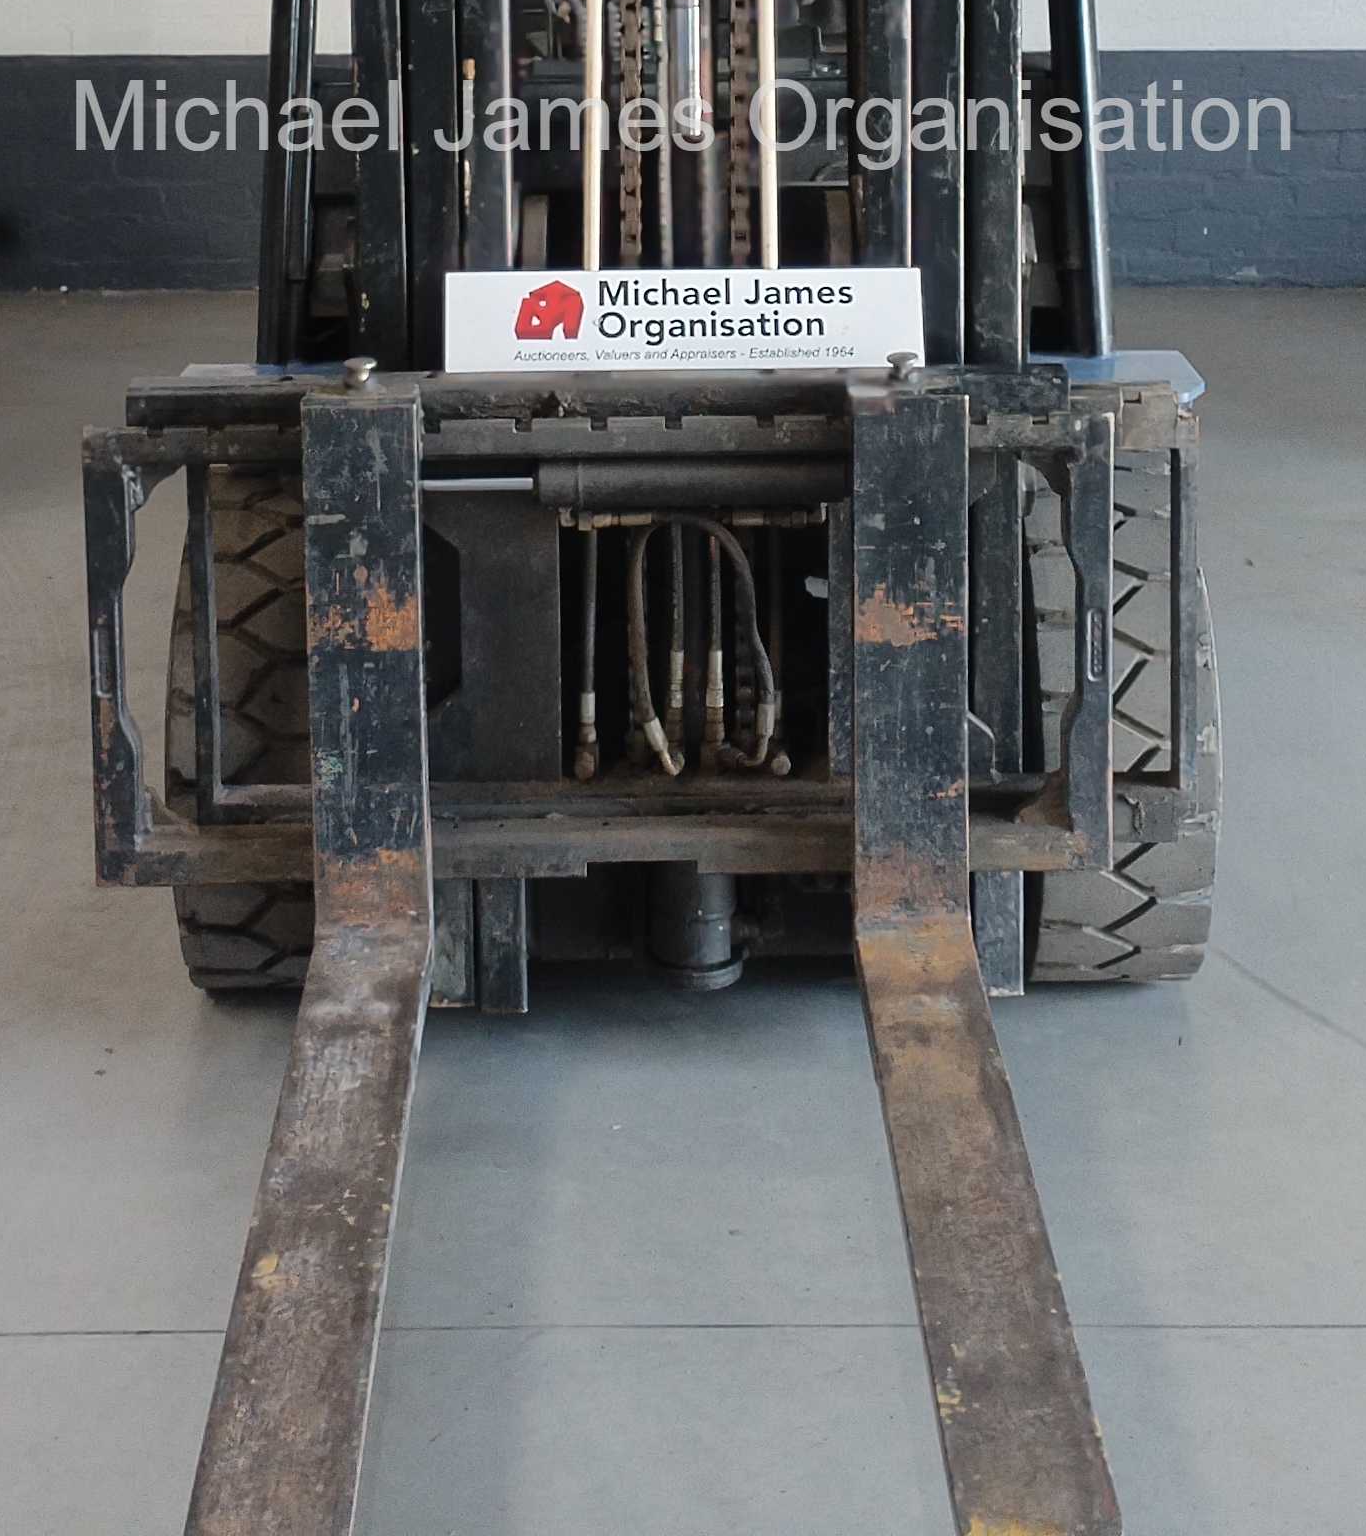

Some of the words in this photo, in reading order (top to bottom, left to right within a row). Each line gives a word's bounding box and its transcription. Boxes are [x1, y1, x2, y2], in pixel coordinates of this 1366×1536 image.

[599, 278, 730, 306] Michael
[745, 279, 852, 304] James
[599, 310, 824, 346] Organisation
[514, 351, 589, 361] Auctioneers,
[595, 350, 640, 360] Valuers
[644, 349, 668, 359] and
[670, 349, 736, 361] Appraisers
[749, 347, 820, 358] Established
[826, 346, 854, 357] 1964
